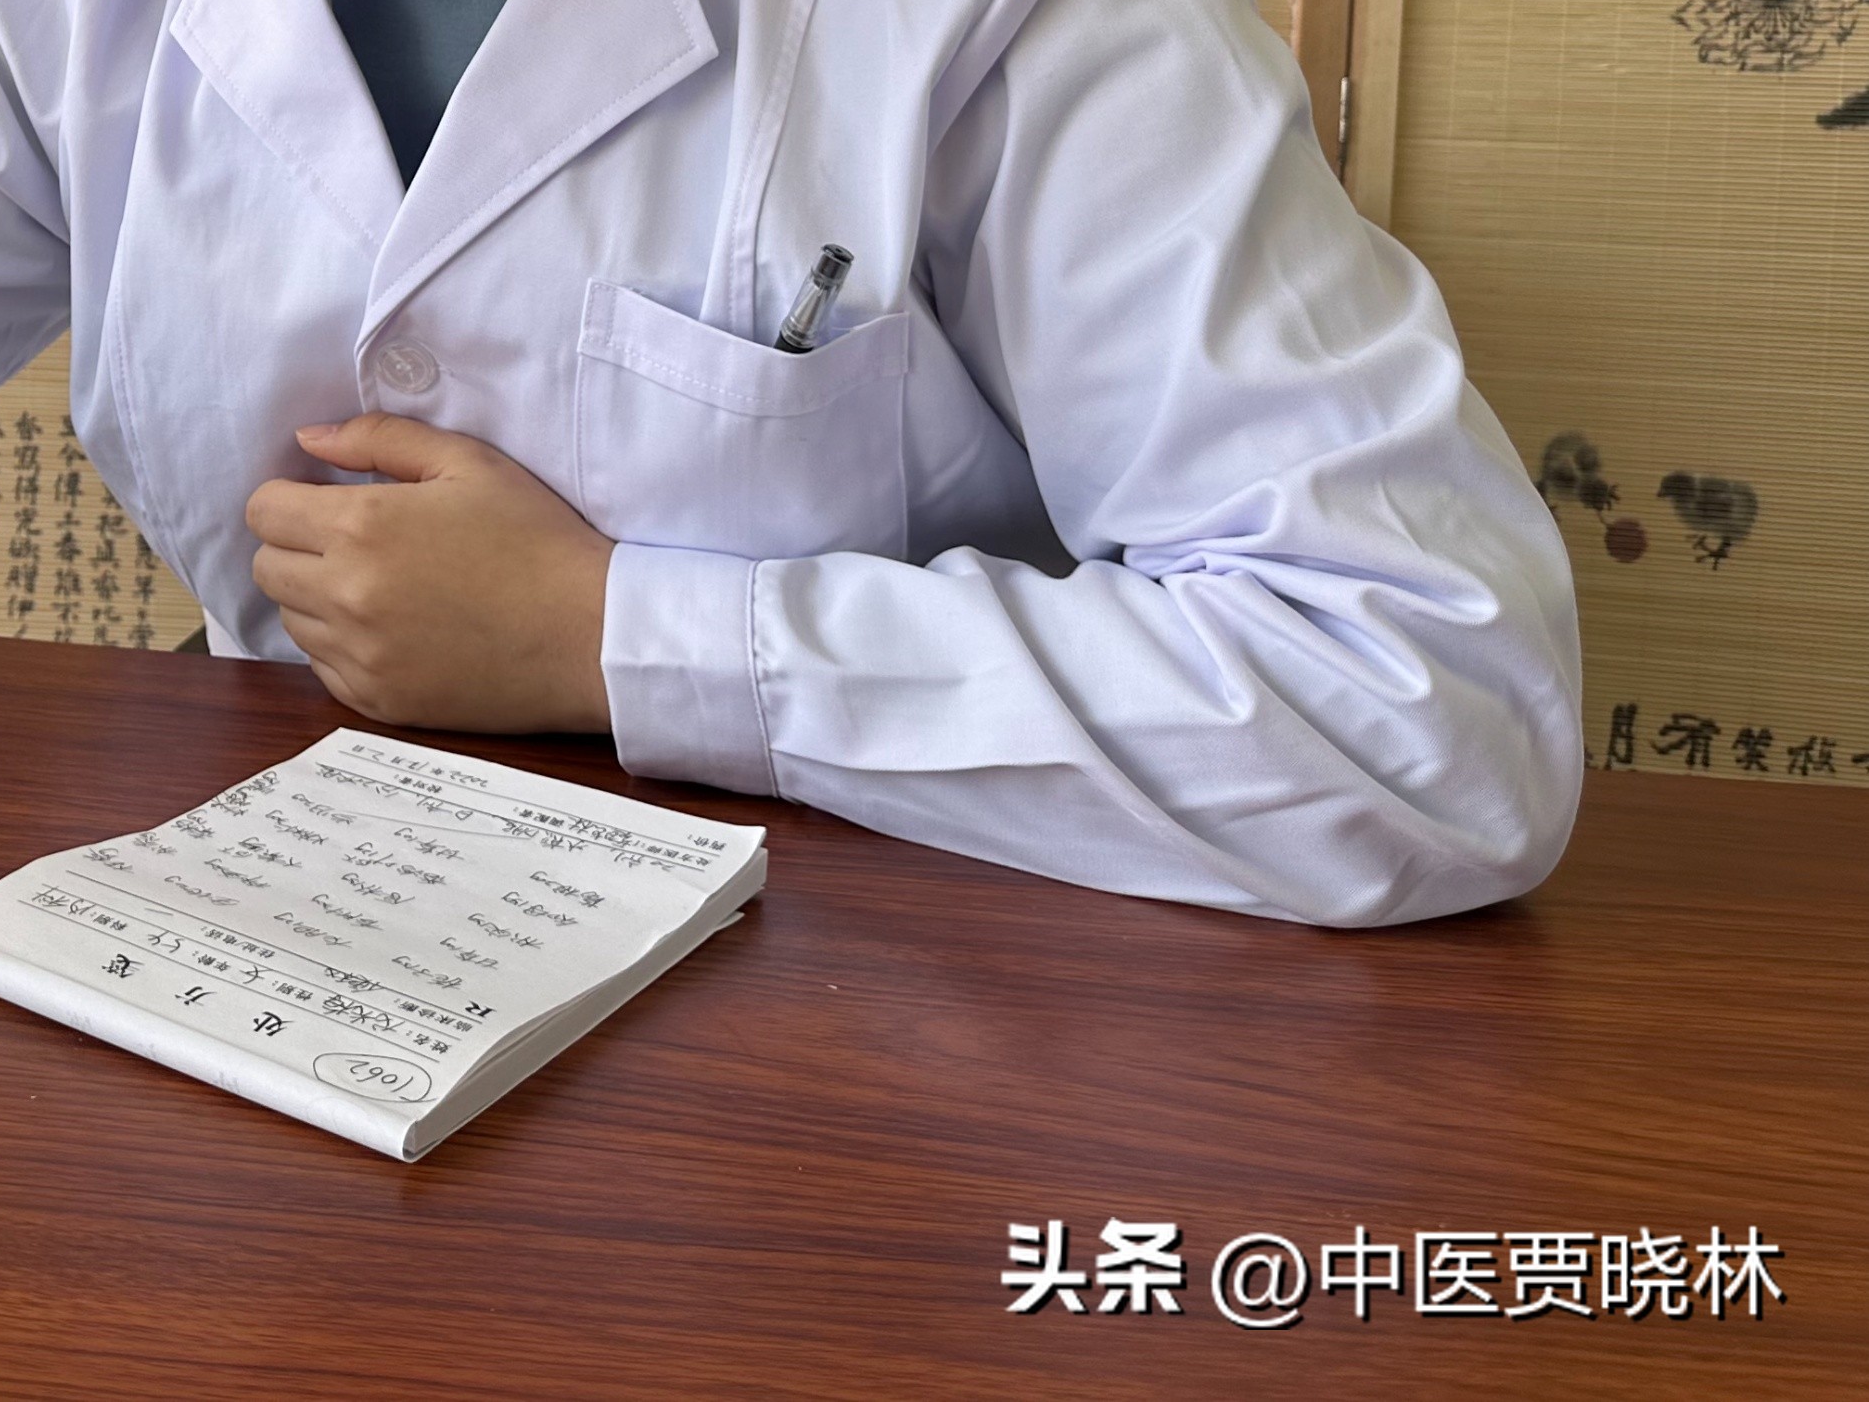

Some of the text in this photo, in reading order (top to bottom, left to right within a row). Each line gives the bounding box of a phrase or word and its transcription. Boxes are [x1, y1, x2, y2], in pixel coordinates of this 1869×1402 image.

[146, 930, 192, 954] 54
[463, 999, 497, 1019] R
[345, 1053, 414, 1093] 1062
